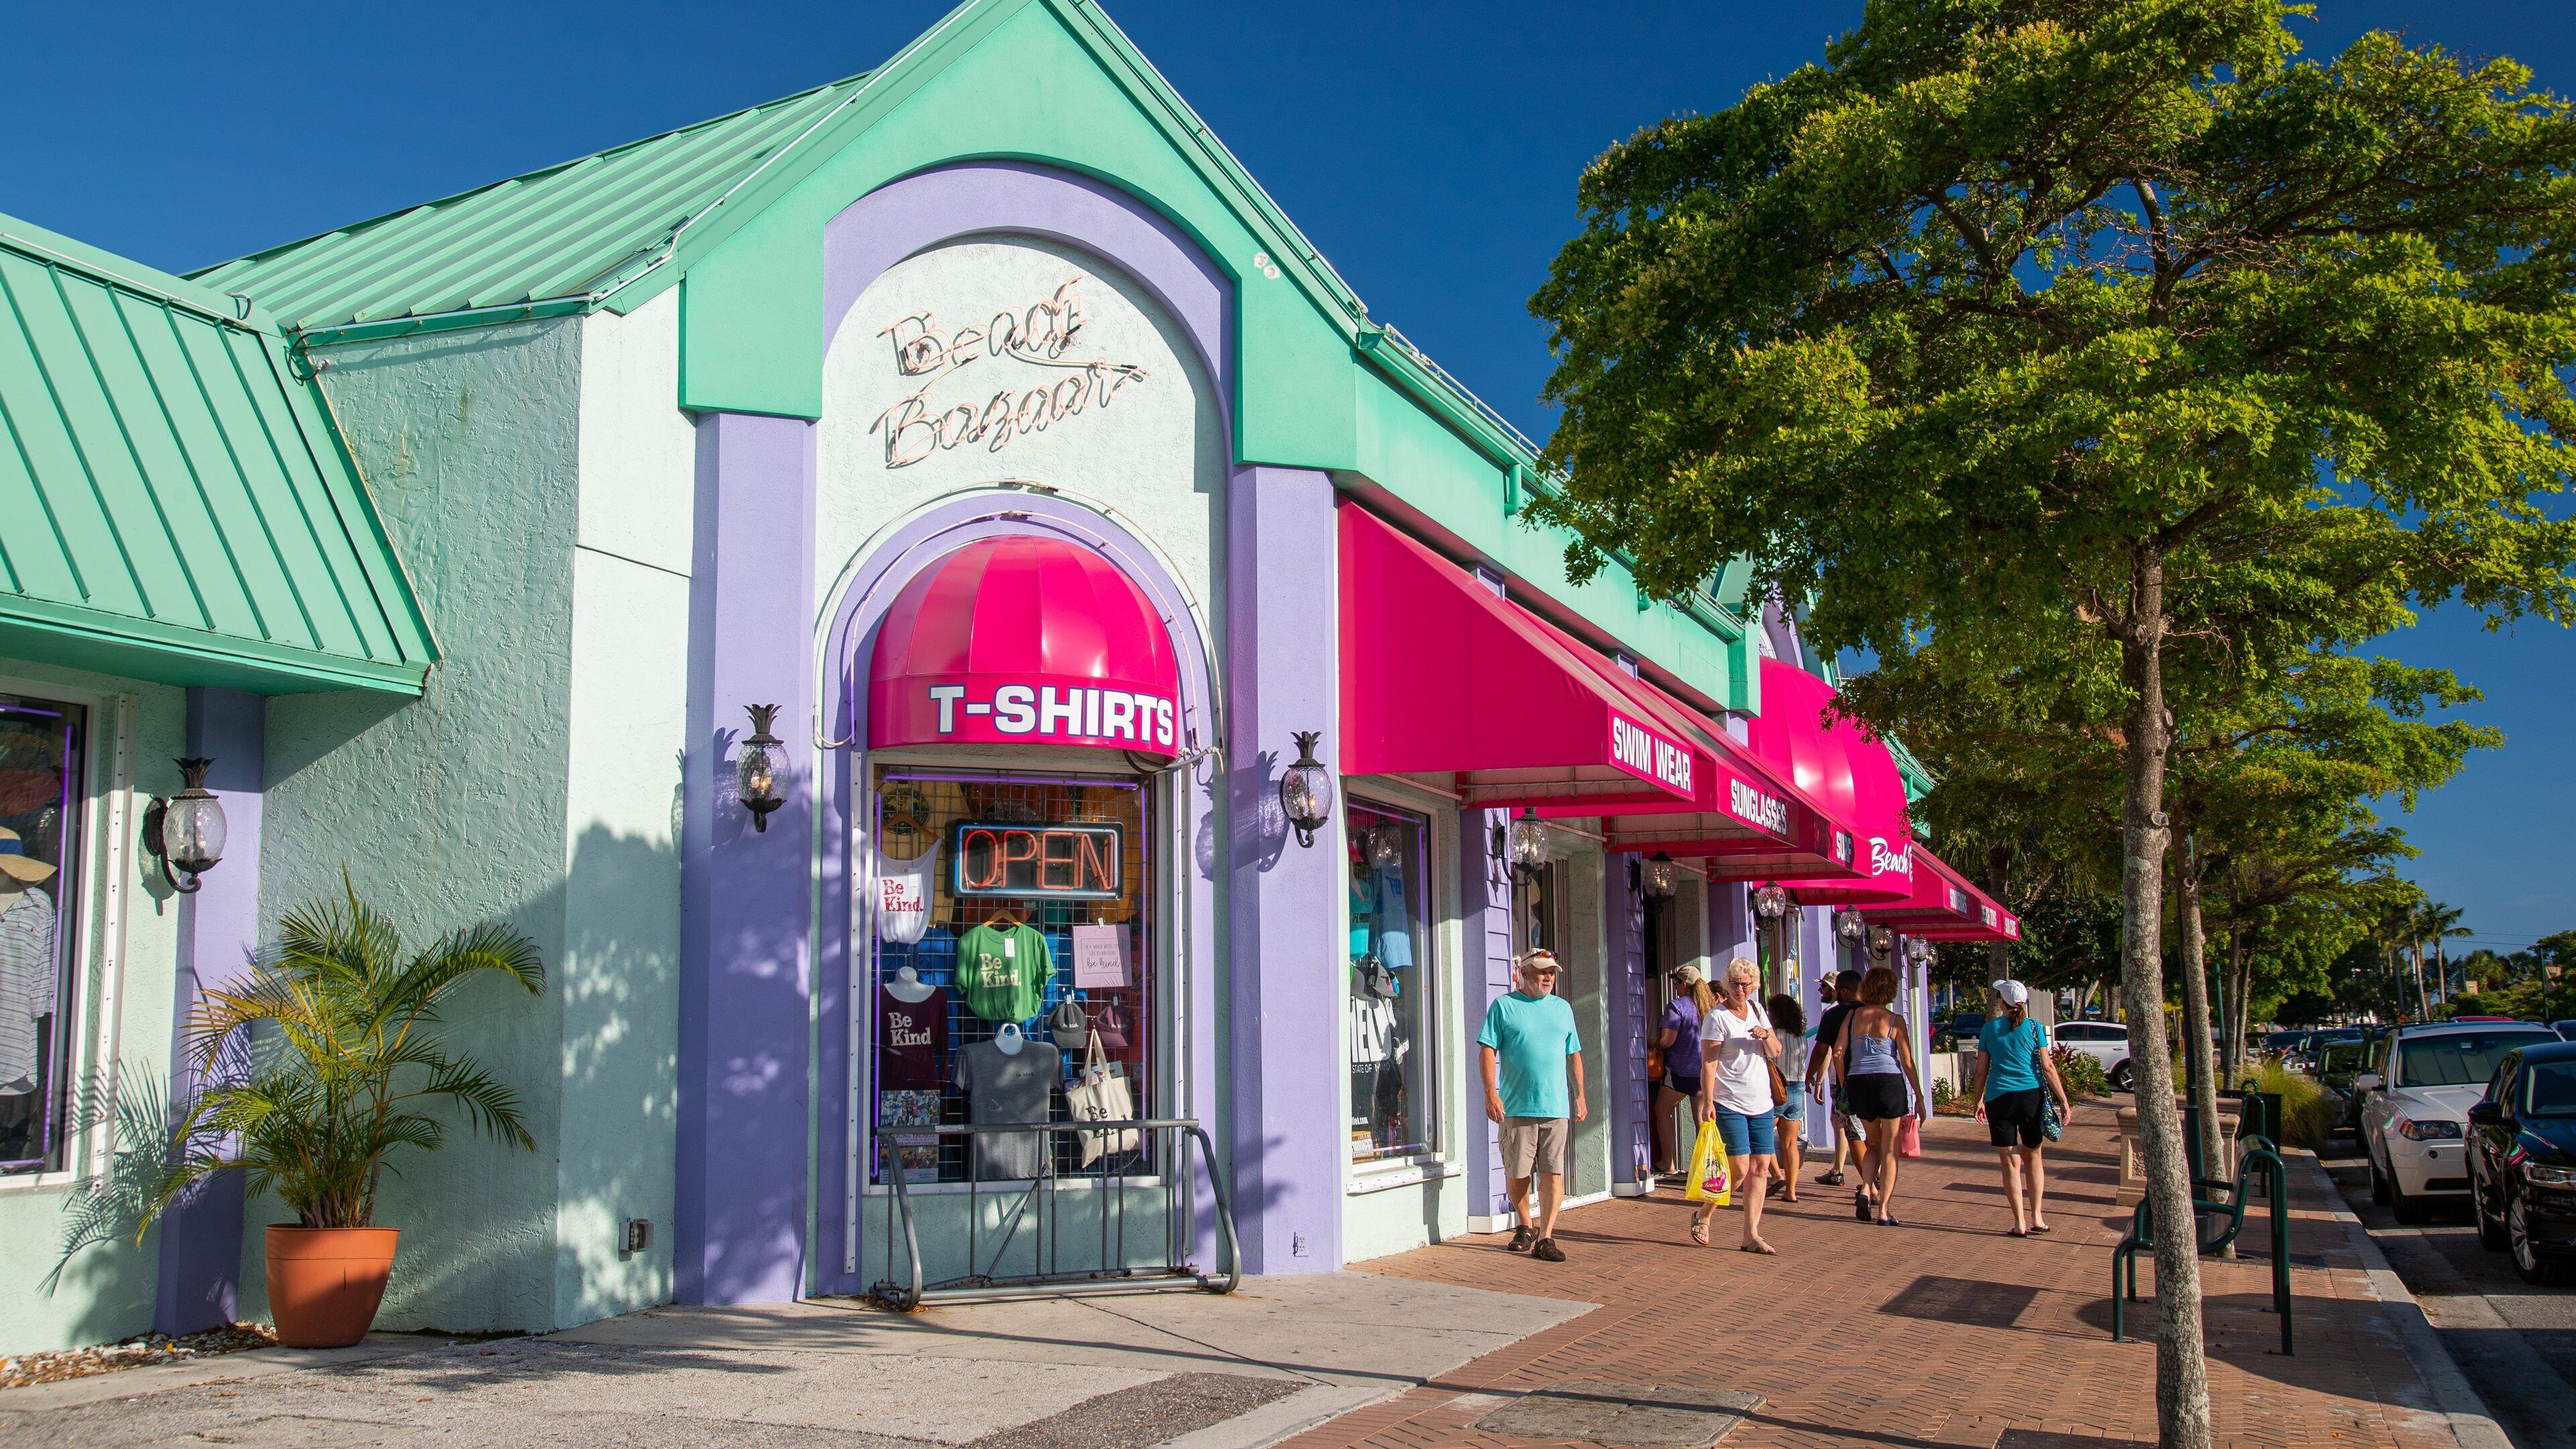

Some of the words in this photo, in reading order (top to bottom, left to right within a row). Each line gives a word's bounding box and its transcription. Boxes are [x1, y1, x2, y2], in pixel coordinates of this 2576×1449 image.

[880, 274, 1090, 370] Beach
[876, 356, 1151, 464] Bazaar
[930, 684, 1174, 747] T-SHIRTS
[1613, 715, 1652, 776] SWIM
[1654, 737, 1691, 793] WEAR
[1731, 777, 1787, 837] SUNGLASSES
[964, 829, 1115, 891] OPEN
[1835, 830, 1851, 864] SURF
[1869, 837, 1909, 876] Beach
[883, 879, 904, 896] Be
[979, 953, 1002, 970] Be
[981, 969, 1022, 987] Kind.
[1087, 957, 1098, 969] be
[888, 1012, 912, 1029] Be
[1352, 1064, 1364, 1073] STATE
[1364, 1064, 1373, 1073] OF
[1085, 1106, 1108, 1121] Be
